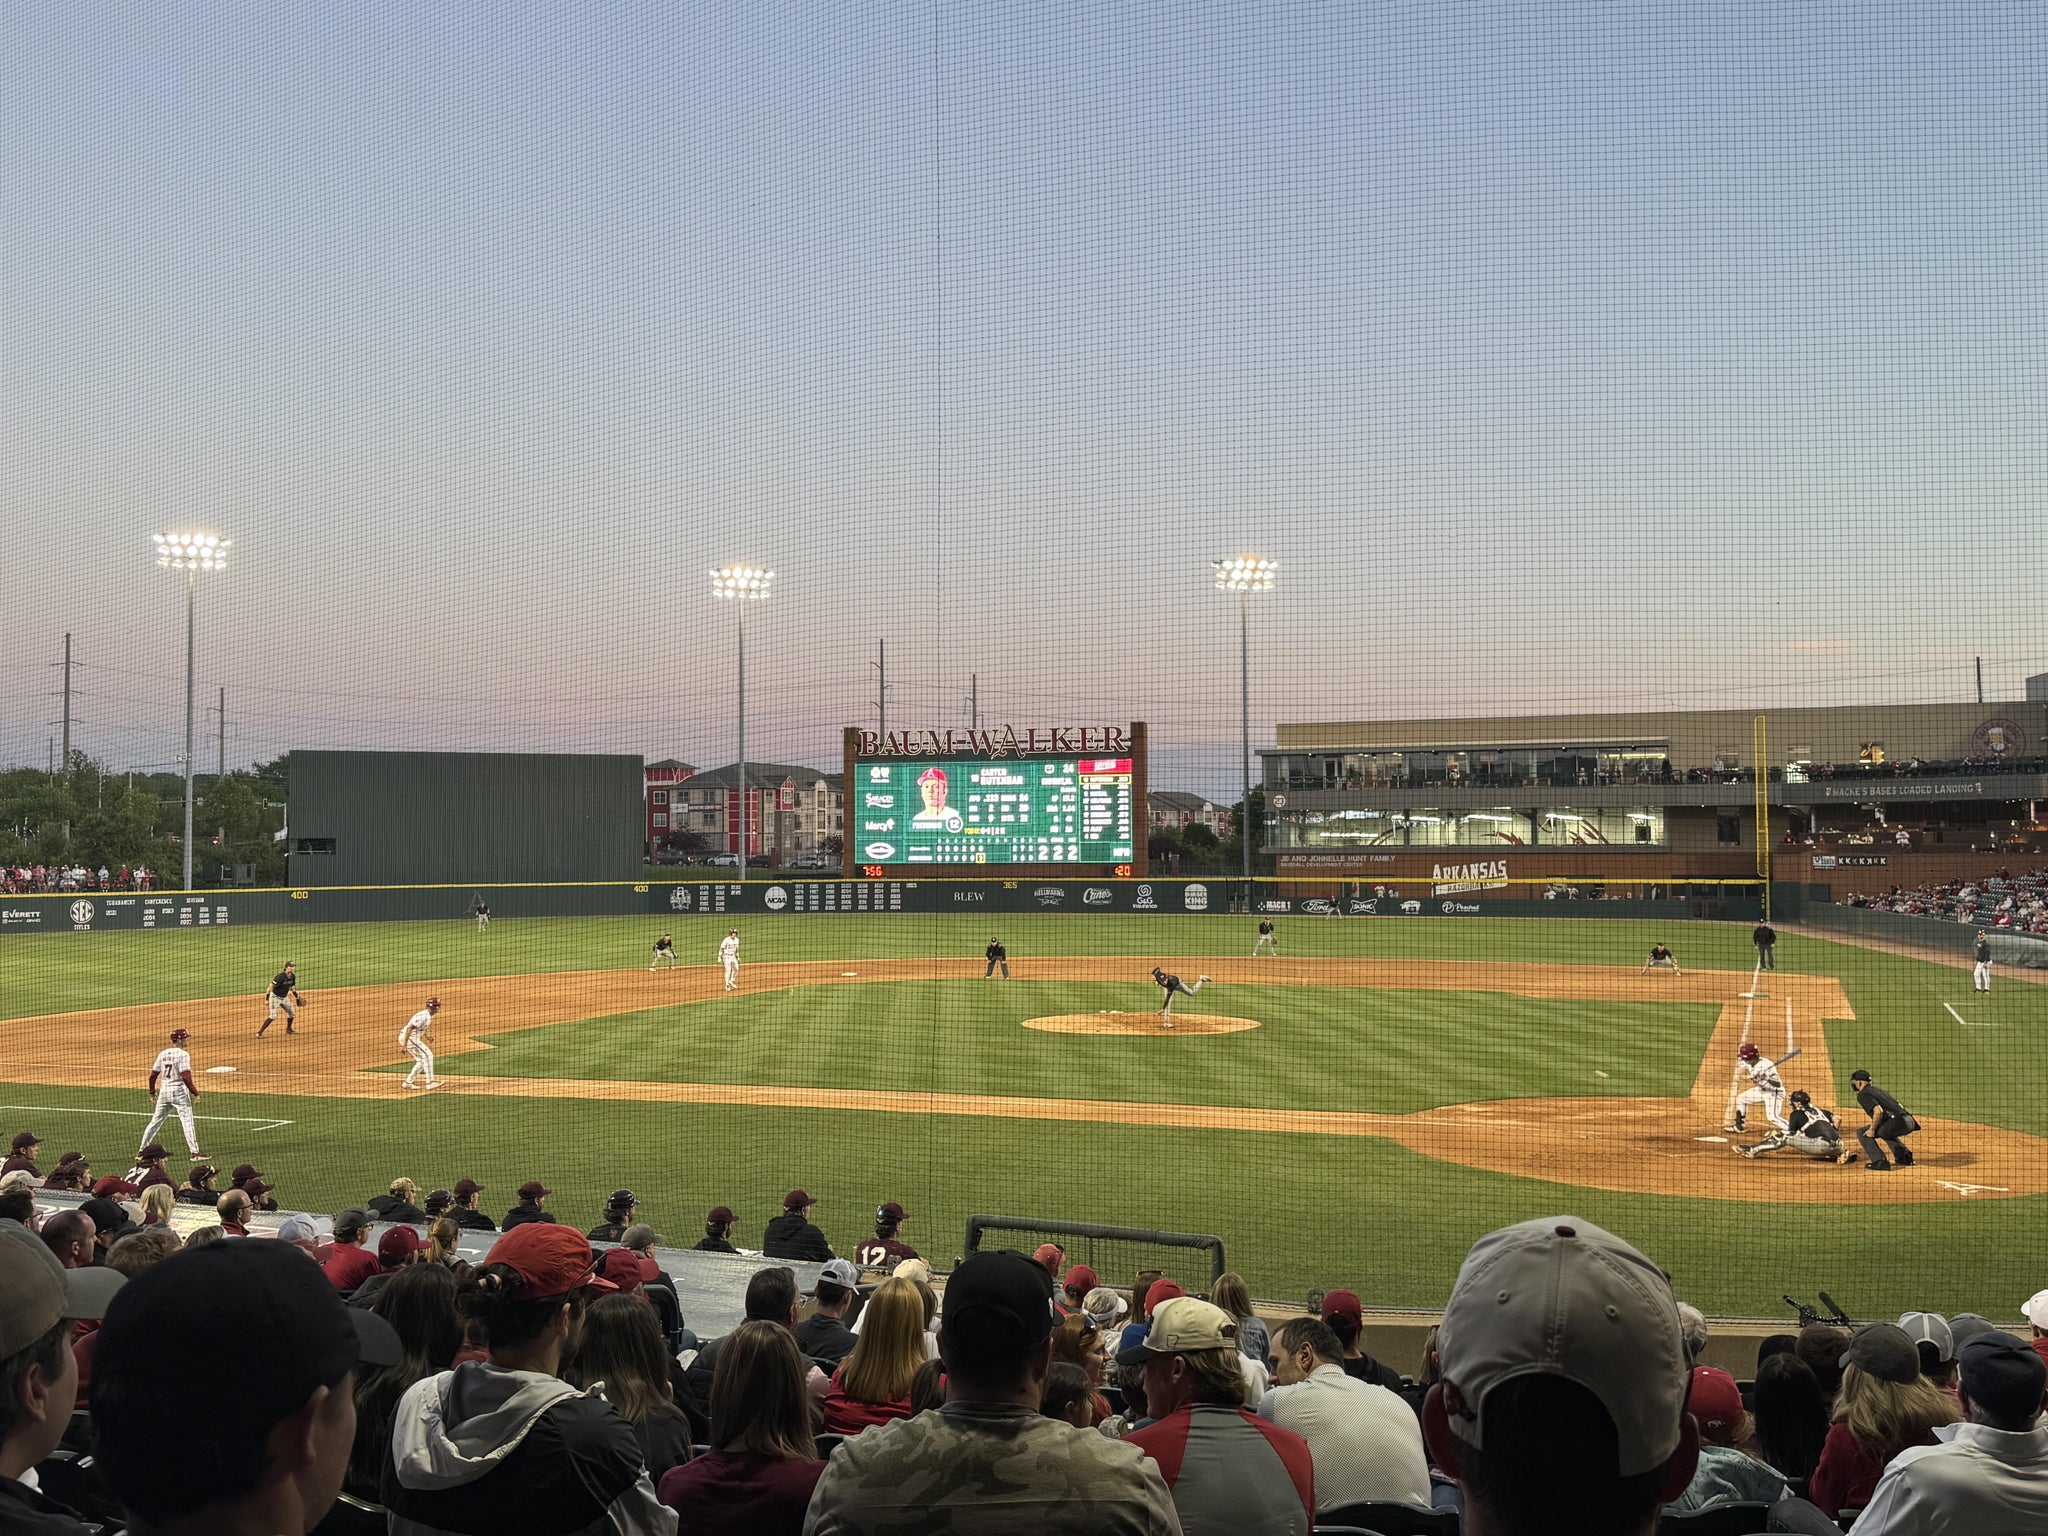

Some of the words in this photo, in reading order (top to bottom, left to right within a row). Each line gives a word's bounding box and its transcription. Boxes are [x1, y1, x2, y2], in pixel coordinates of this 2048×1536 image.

[858, 723, 1129, 760] BAUM-WALKER
[1934, 784, 1973, 795] LANDING
[1038, 845, 1048, 860] 2
[1053, 845, 1063, 860] 2
[1067, 845, 1077, 860] 2
[1433, 860, 1507, 881] ARKANSAS
[290, 891, 309, 900] 400
[634, 885, 649, 893] 400
[1083, 888, 1112, 904] Cane's
[954, 892, 985, 901] BLEW
[1185, 897, 1207, 905] KING
[73, 901, 92, 922] SEC
[1266, 901, 1286, 909] MACH
[1307, 902, 1330, 911] Ford
[2, 909, 41, 919] EVERETT
[164, 1064, 172, 1078] 7
[124, 1166, 150, 1185] 27
[861, 1246, 886, 1266] 12
